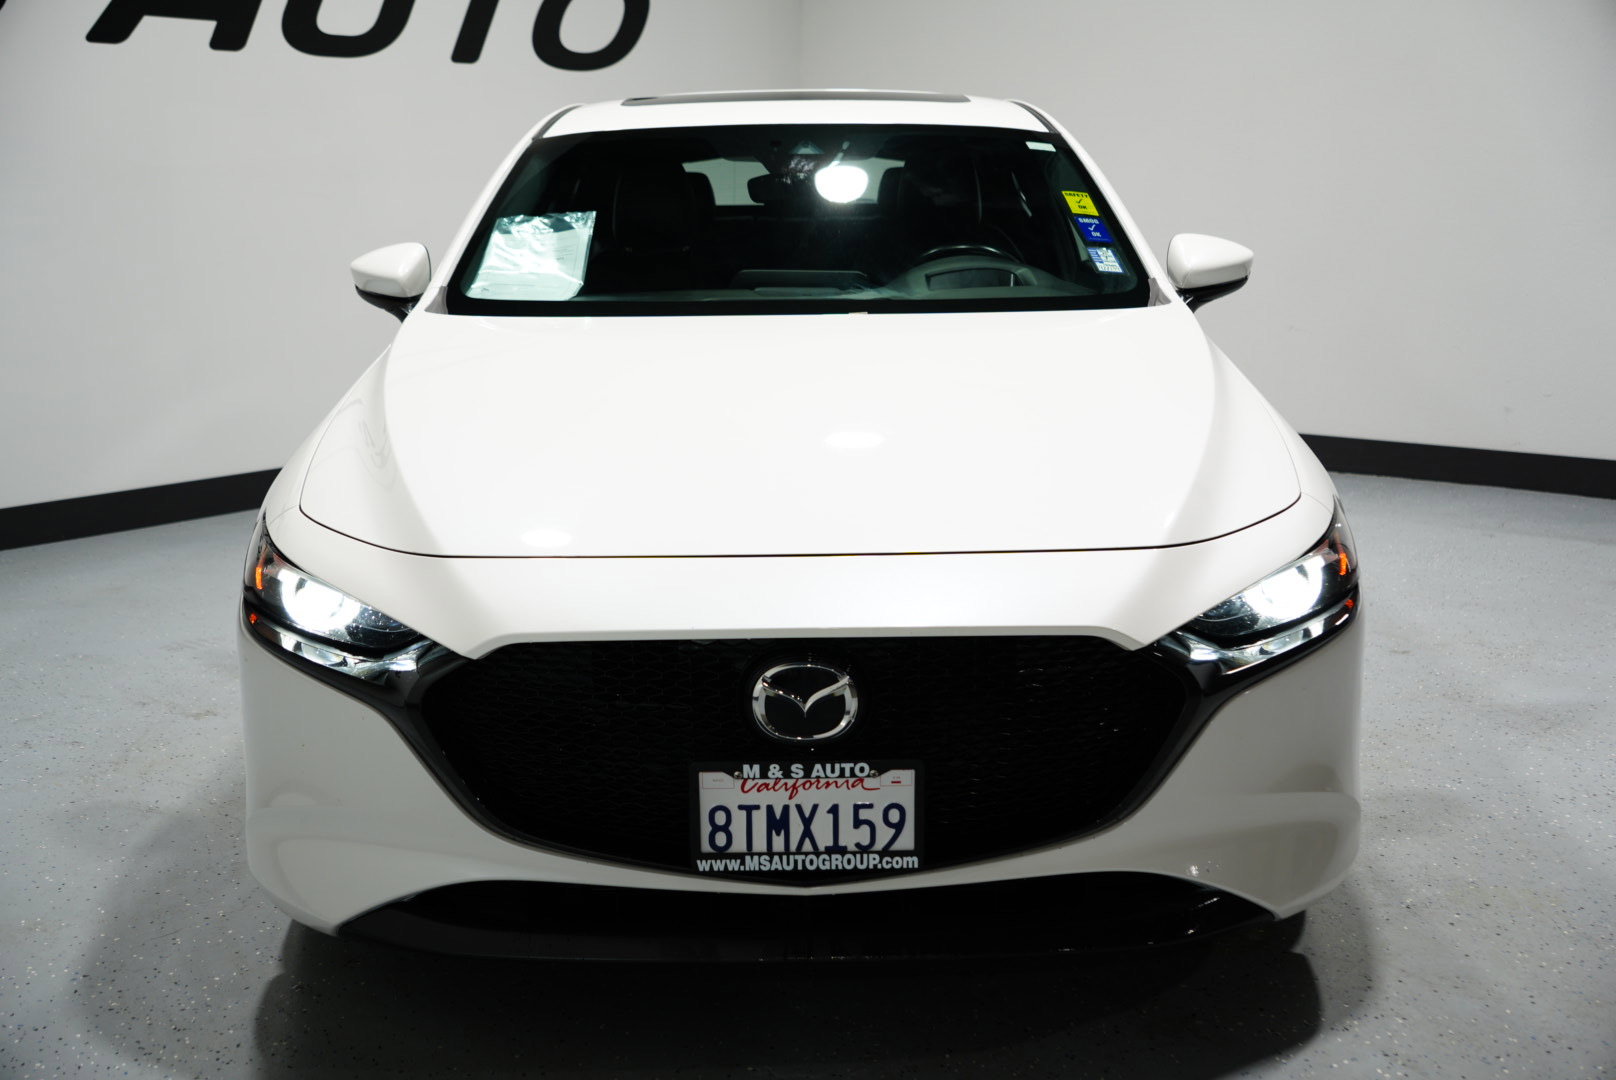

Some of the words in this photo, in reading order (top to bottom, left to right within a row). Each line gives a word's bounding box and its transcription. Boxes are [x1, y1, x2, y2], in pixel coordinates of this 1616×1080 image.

[742, 764, 760, 779] M
[767, 764, 784, 779] &
[790, 763, 805, 779] S
[810, 762, 870, 778] AUTO
[740, 777, 881, 800] California
[707, 802, 907, 852] 8TMX159
[696, 854, 919, 871] www.MSAUTOGROUP.com
